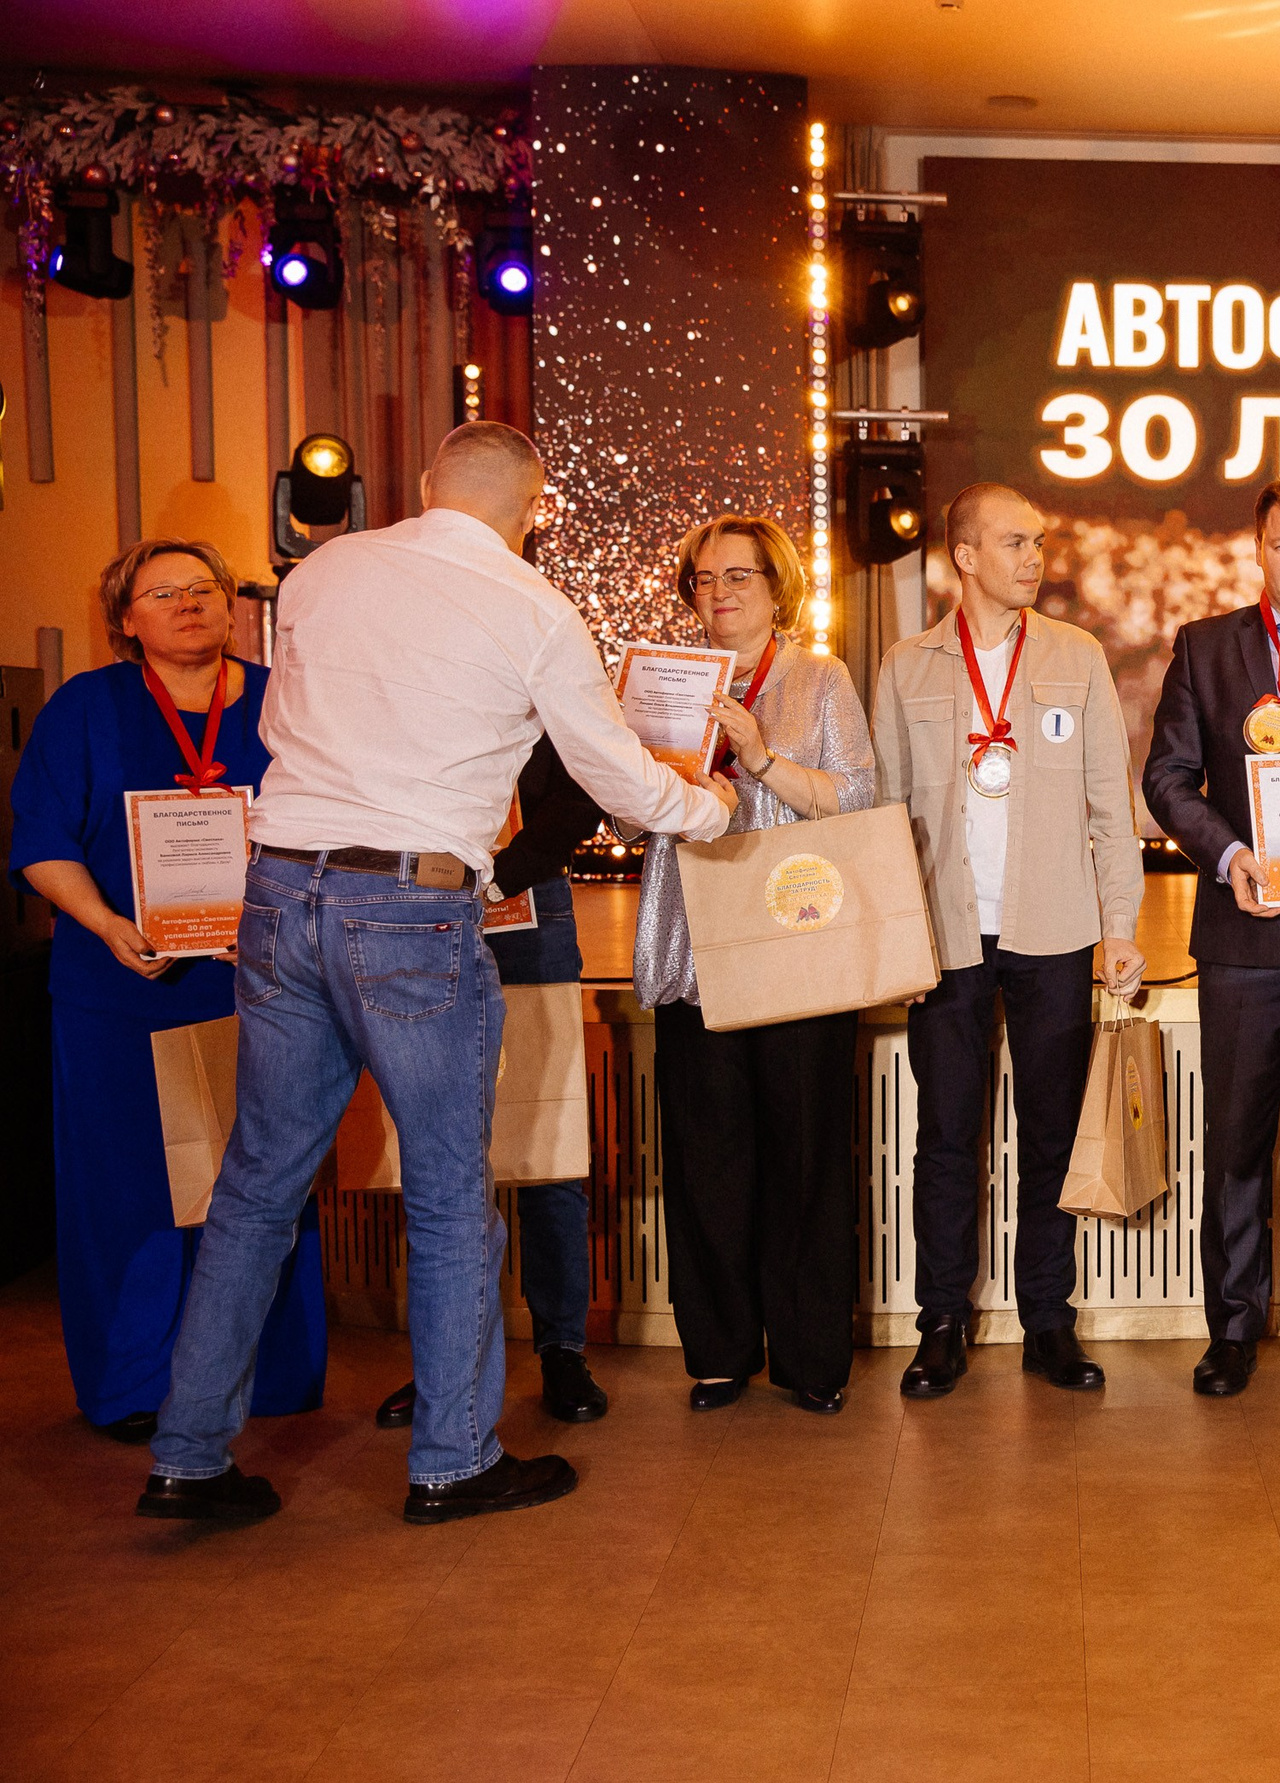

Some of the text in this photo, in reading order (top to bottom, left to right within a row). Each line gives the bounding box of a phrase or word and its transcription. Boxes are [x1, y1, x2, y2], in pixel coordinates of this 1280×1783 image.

[1040, 393, 1198, 482] 30
[642, 665, 710, 677] БЛАГОДАРСТВЕННОЕ
[658, 675, 687, 683] ПИСЬМО
[1051, 713, 1065, 737] 1
[153, 809, 233, 819] БЛАГОДАРСТВЕННОЕ
[176, 820, 209, 828] ПИСЬМО
[164, 931, 205, 940] успешной
